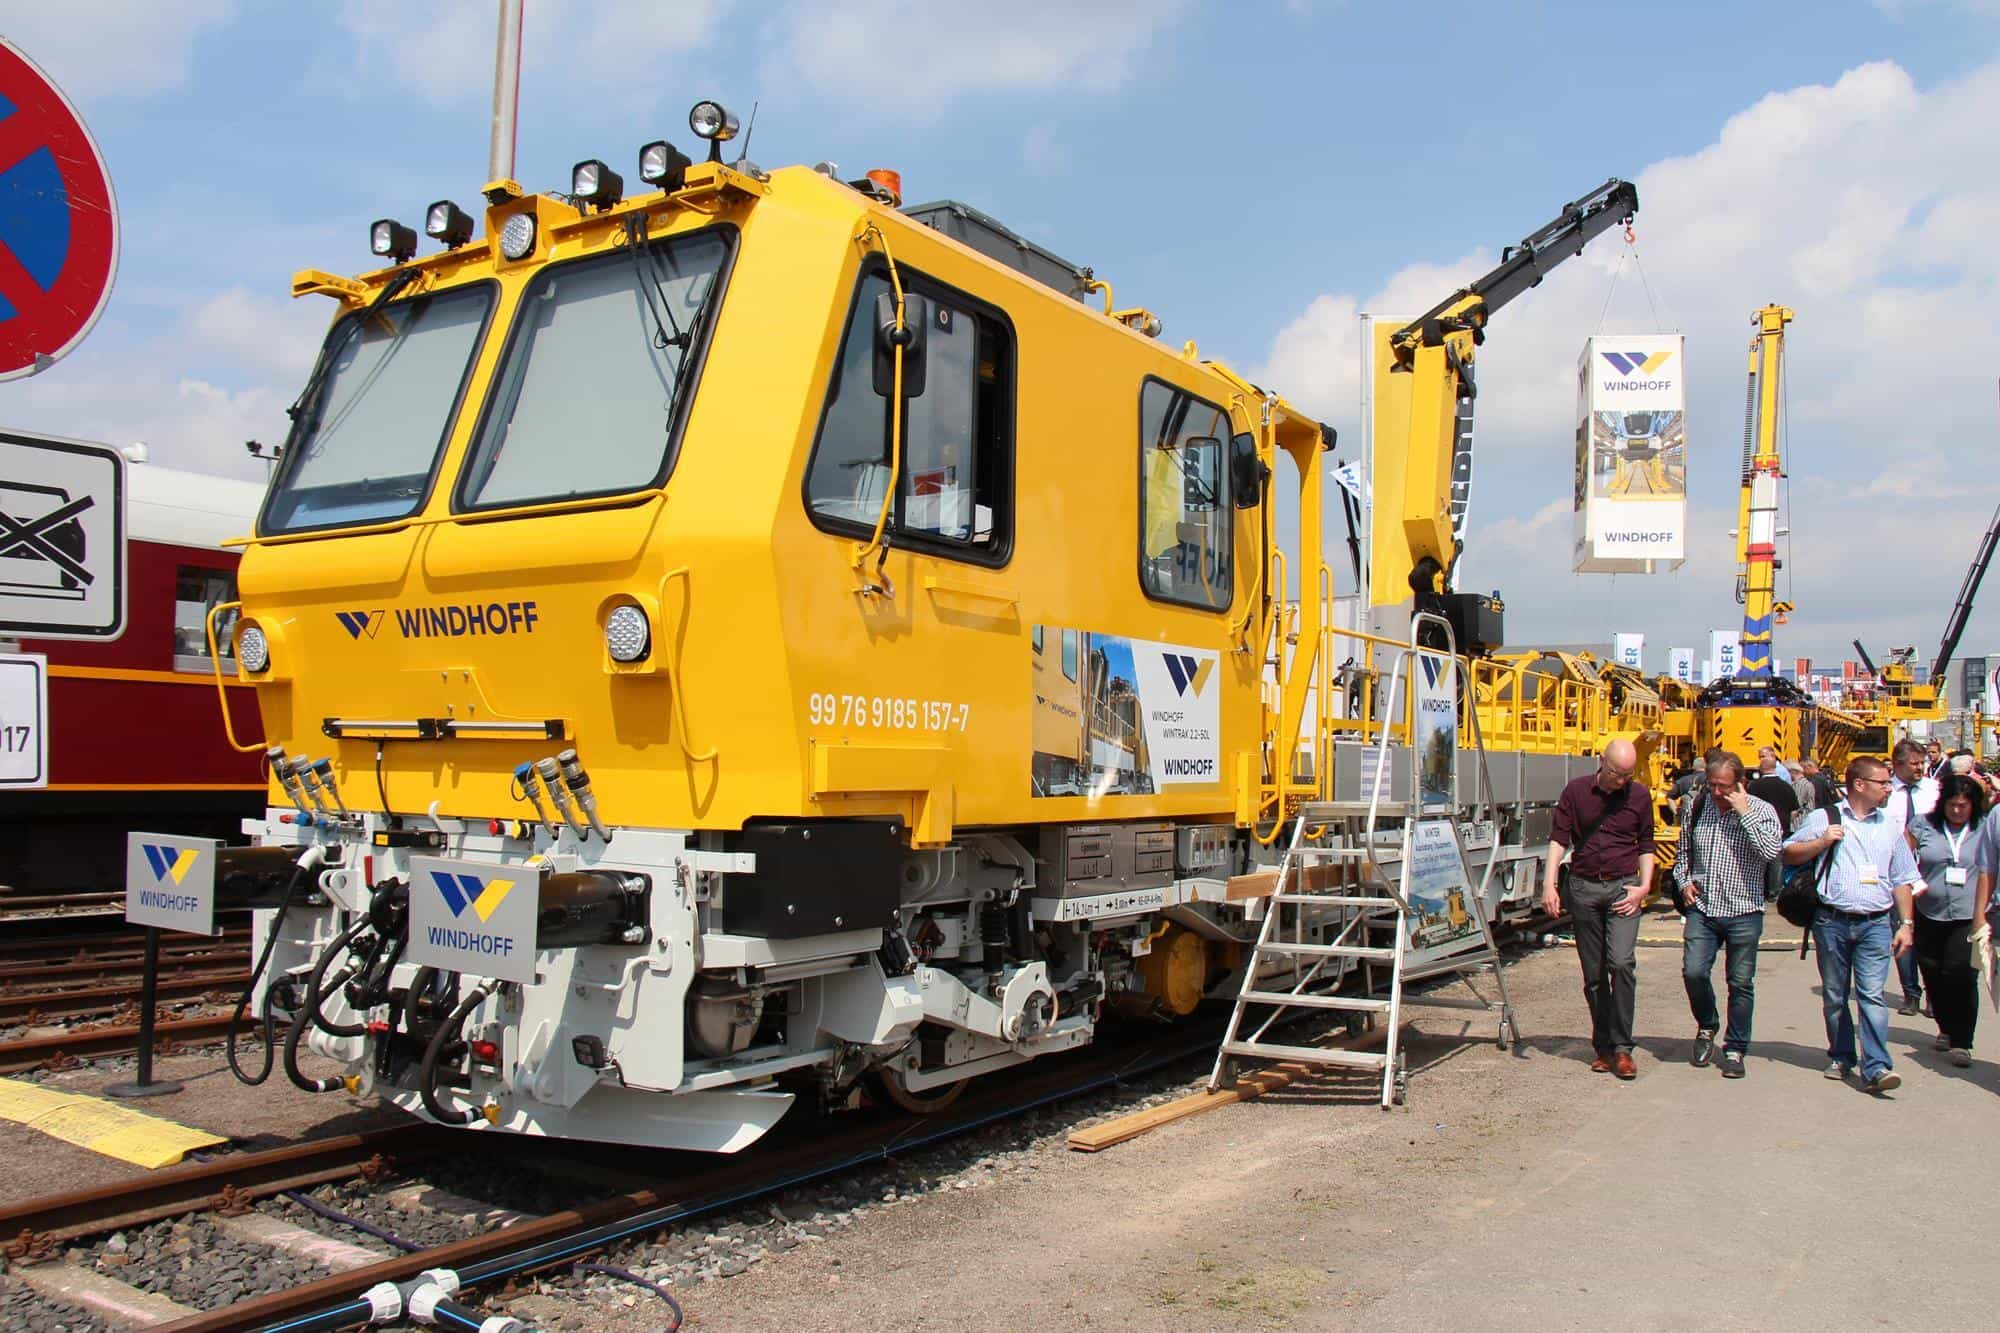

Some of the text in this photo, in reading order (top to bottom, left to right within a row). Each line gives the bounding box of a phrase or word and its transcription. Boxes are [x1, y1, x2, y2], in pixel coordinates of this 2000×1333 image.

[1603, 380, 1672, 391] WINDHOFF
[1604, 532, 1673, 543] WINDHOFF
[395, 601, 539, 638] WINDHOFF
[809, 692, 969, 732] 99 76 9185 157-7
[1421, 698, 1451, 713] WINDHOFF
[1152, 711, 1184, 722] WINDHOFF
[0, 726, 30, 752] 17
[1164, 759, 1213, 775] WINDHOFF
[140, 890, 198, 912] WINDHOFF
[427, 926, 513, 956] WINDHOFF
